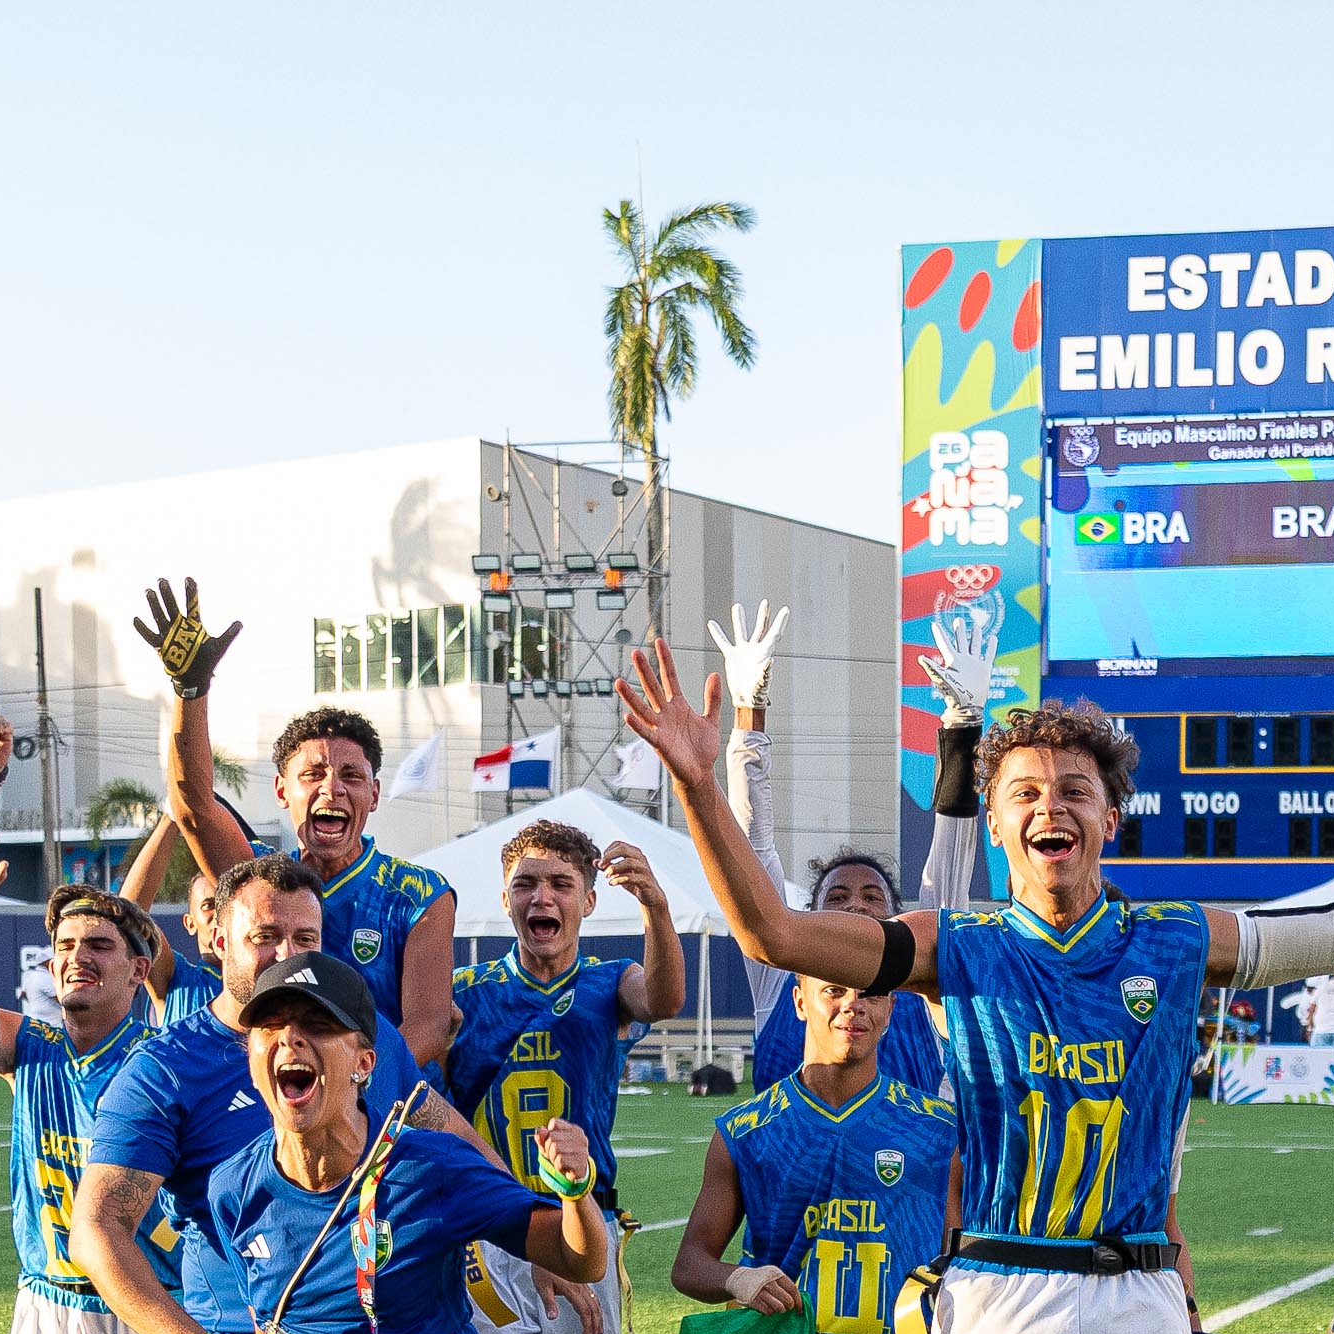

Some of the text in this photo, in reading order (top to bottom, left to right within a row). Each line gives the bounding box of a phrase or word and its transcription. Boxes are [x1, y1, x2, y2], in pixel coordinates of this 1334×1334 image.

[1059, 329, 1285, 391] EMILIO
[1115, 426, 1173, 448] Equipo
[1174, 422, 1257, 443] Masculino
[1259, 420, 1318, 440] Finales
[1208, 445, 1265, 460] Ganador
[1268, 443, 1291, 458] del
[1123, 510, 1190, 544] BRA
[1127, 791, 1160, 815] WN
[1018, 1090, 1130, 1239] 10
